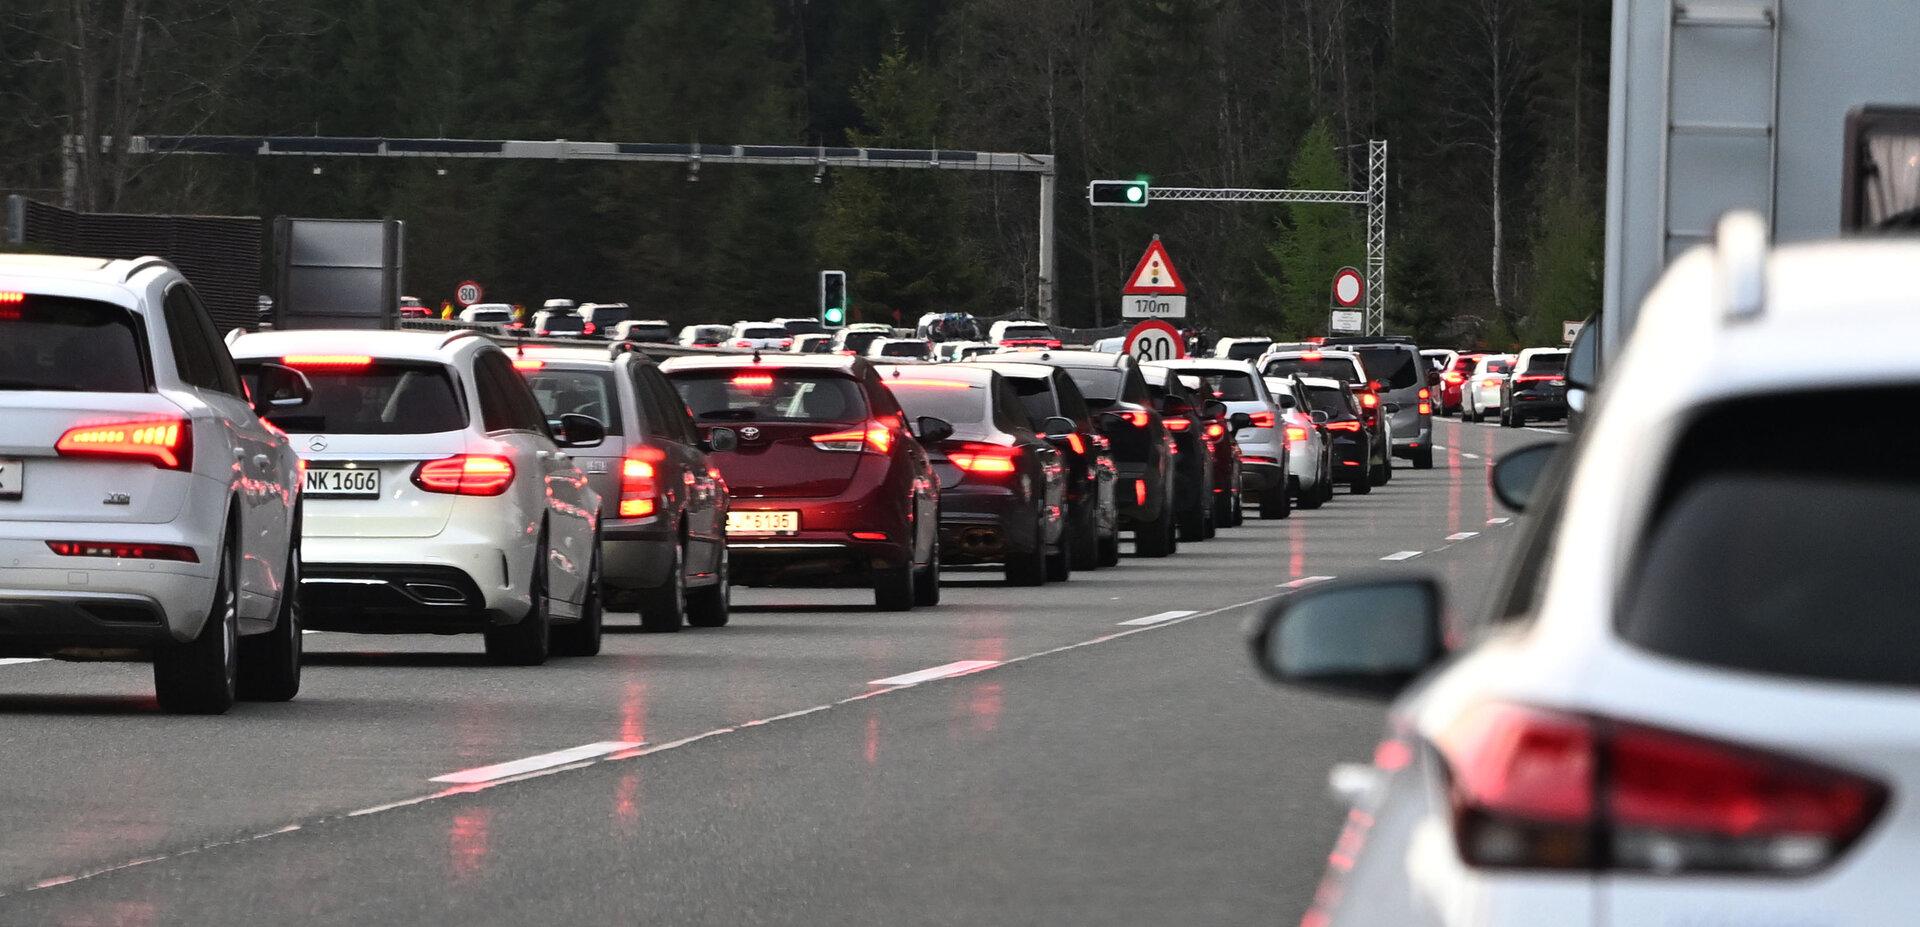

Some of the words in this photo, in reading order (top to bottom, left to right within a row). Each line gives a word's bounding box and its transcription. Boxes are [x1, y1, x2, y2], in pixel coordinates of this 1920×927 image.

[461, 288, 475, 300] 80
[1135, 299, 1170, 313] 170m
[1137, 337, 1170, 361] 80
[306, 471, 329, 490] NK
[332, 471, 376, 490] 1606
